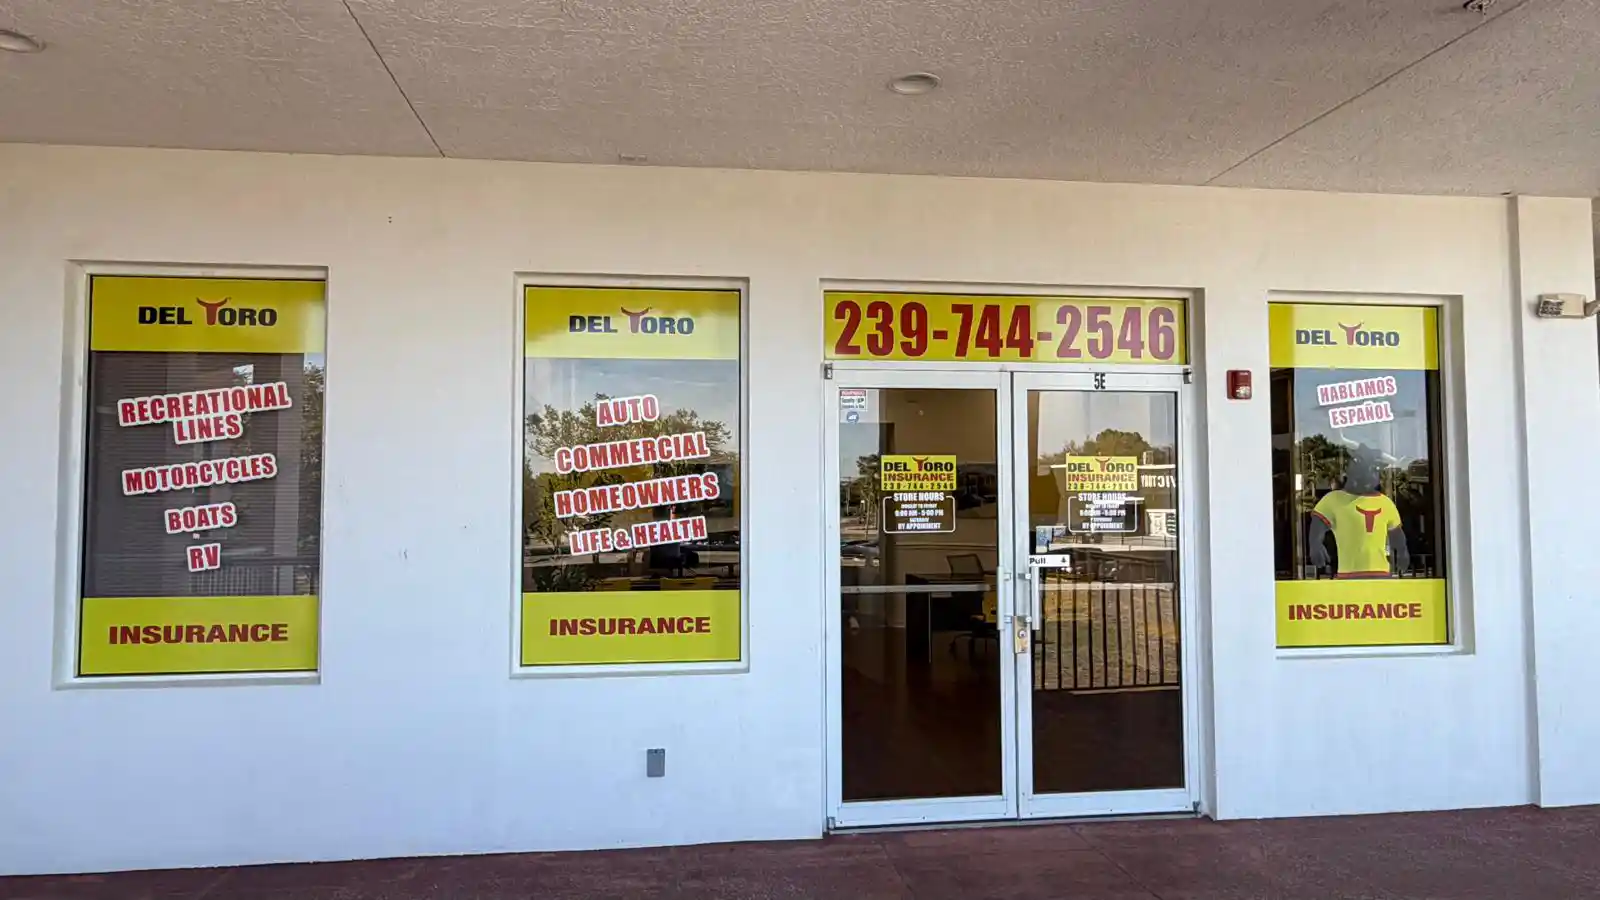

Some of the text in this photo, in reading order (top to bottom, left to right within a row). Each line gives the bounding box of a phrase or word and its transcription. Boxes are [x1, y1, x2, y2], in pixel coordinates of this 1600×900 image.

[138, 306, 192, 325] DEL
[569, 315, 618, 333] DEL
[834, 300, 1175, 360] 239-744-2546
[1296, 329, 1337, 345] DEL
[1094, 371, 1106, 390] 5E
[1319, 377, 1396, 404] HABLAMOS
[120, 382, 291, 425] RECREATIONAL
[598, 396, 658, 426] AUTO
[1331, 403, 1393, 428] ESPAÑOL
[175, 415, 241, 443] LINES
[556, 433, 709, 473] COMMERCIAL
[124, 455, 275, 493] MOTORCYCLES
[884, 462, 911, 472] DEL
[884, 473, 954, 481] INSURANCE
[1068, 463, 1094, 472] DEL
[1068, 474, 1135, 482] INSURANCE
[556, 474, 719, 517] HOMEOWNERS
[894, 492, 944, 502] STORE HOURS
[166, 503, 235, 532] BOATS
[571, 517, 706, 555] LIFE & HEALTH
[187, 544, 220, 571] RV
[1029, 557, 1046, 565] Pull
[1288, 603, 1422, 621] INSURANCE
[109, 624, 289, 645] INSURANCE
[550, 616, 711, 636] INSURANCE
